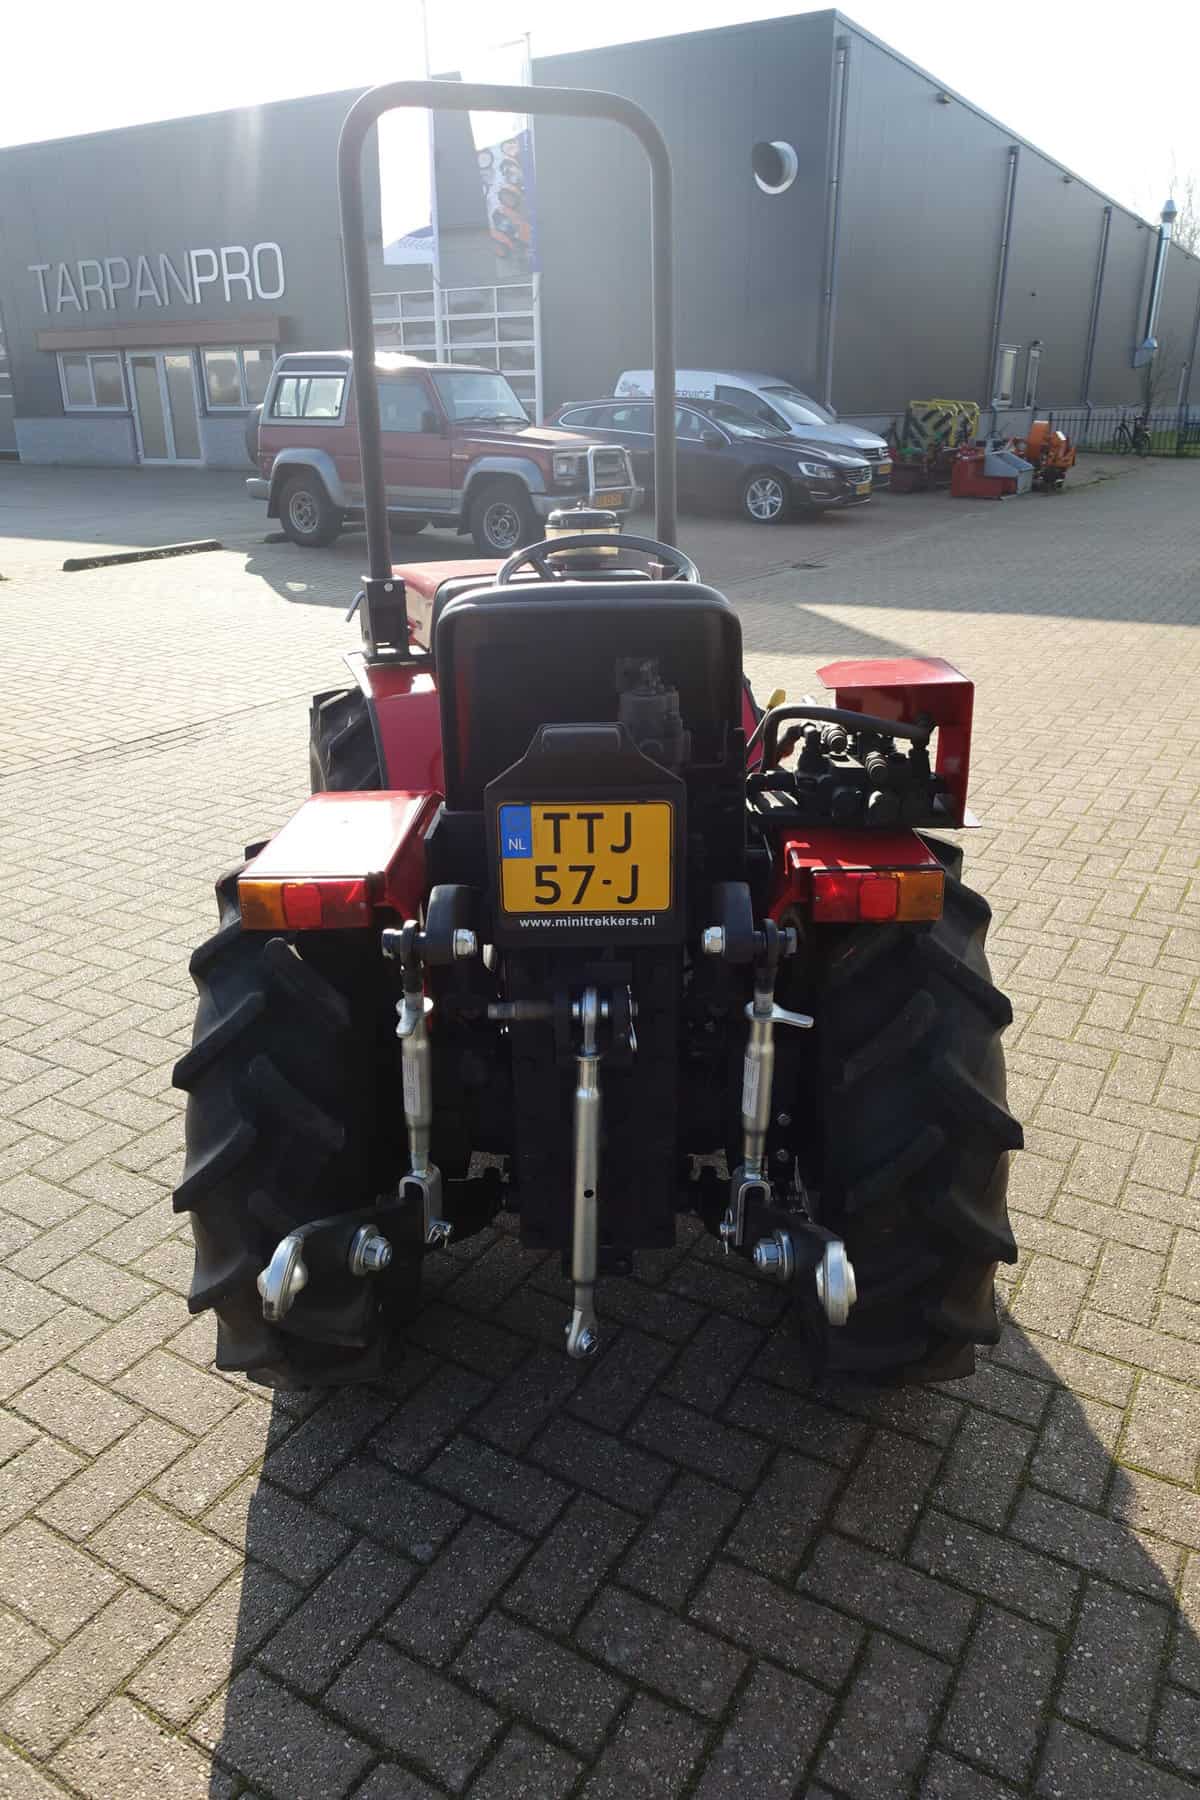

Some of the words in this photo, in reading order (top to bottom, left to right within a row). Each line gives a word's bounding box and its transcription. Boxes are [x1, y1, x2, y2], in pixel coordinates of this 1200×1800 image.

[28, 242, 286, 312] TARPANPRO
[508, 838, 526, 850] NL
[543, 812, 632, 854] TTJ
[535, 864, 639, 905] 57-J
[519, 915, 656, 928] www.minitrekkers.nl
